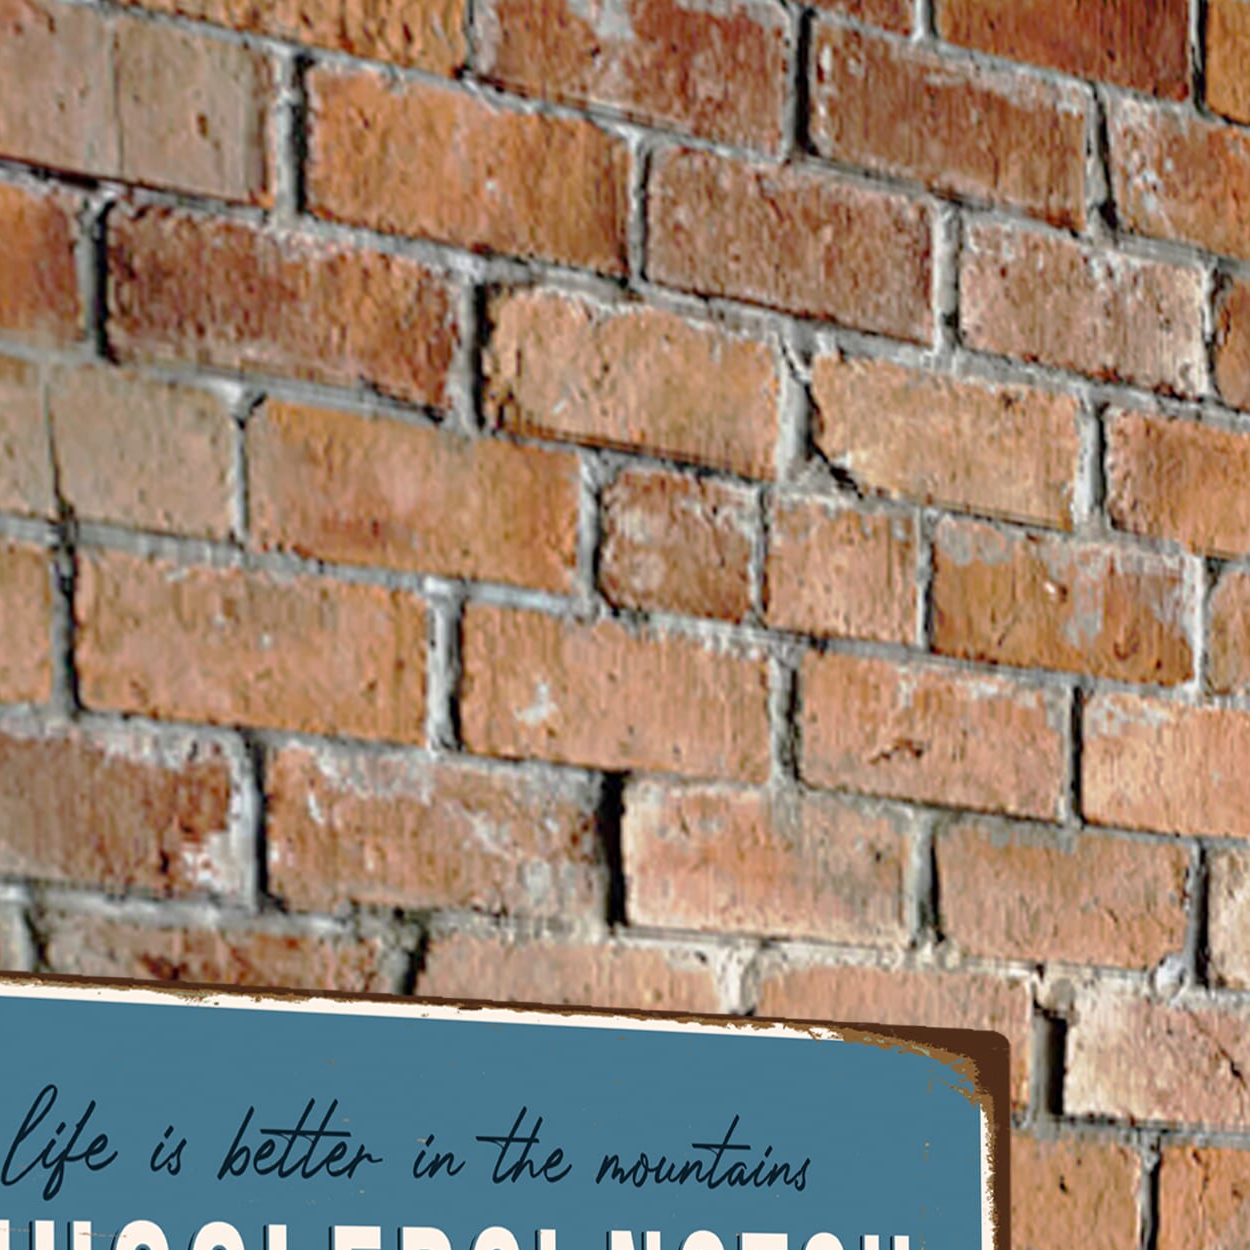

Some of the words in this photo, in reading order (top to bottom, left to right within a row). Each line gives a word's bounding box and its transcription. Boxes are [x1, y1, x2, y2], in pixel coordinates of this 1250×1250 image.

[0, 1084, 119, 1200] life
[149, 1125, 185, 1175] is
[217, 1097, 383, 1181] better
[412, 1133, 466, 1179] in
[476, 1105, 573, 1184] the
[596, 1114, 811, 1192] mountains
